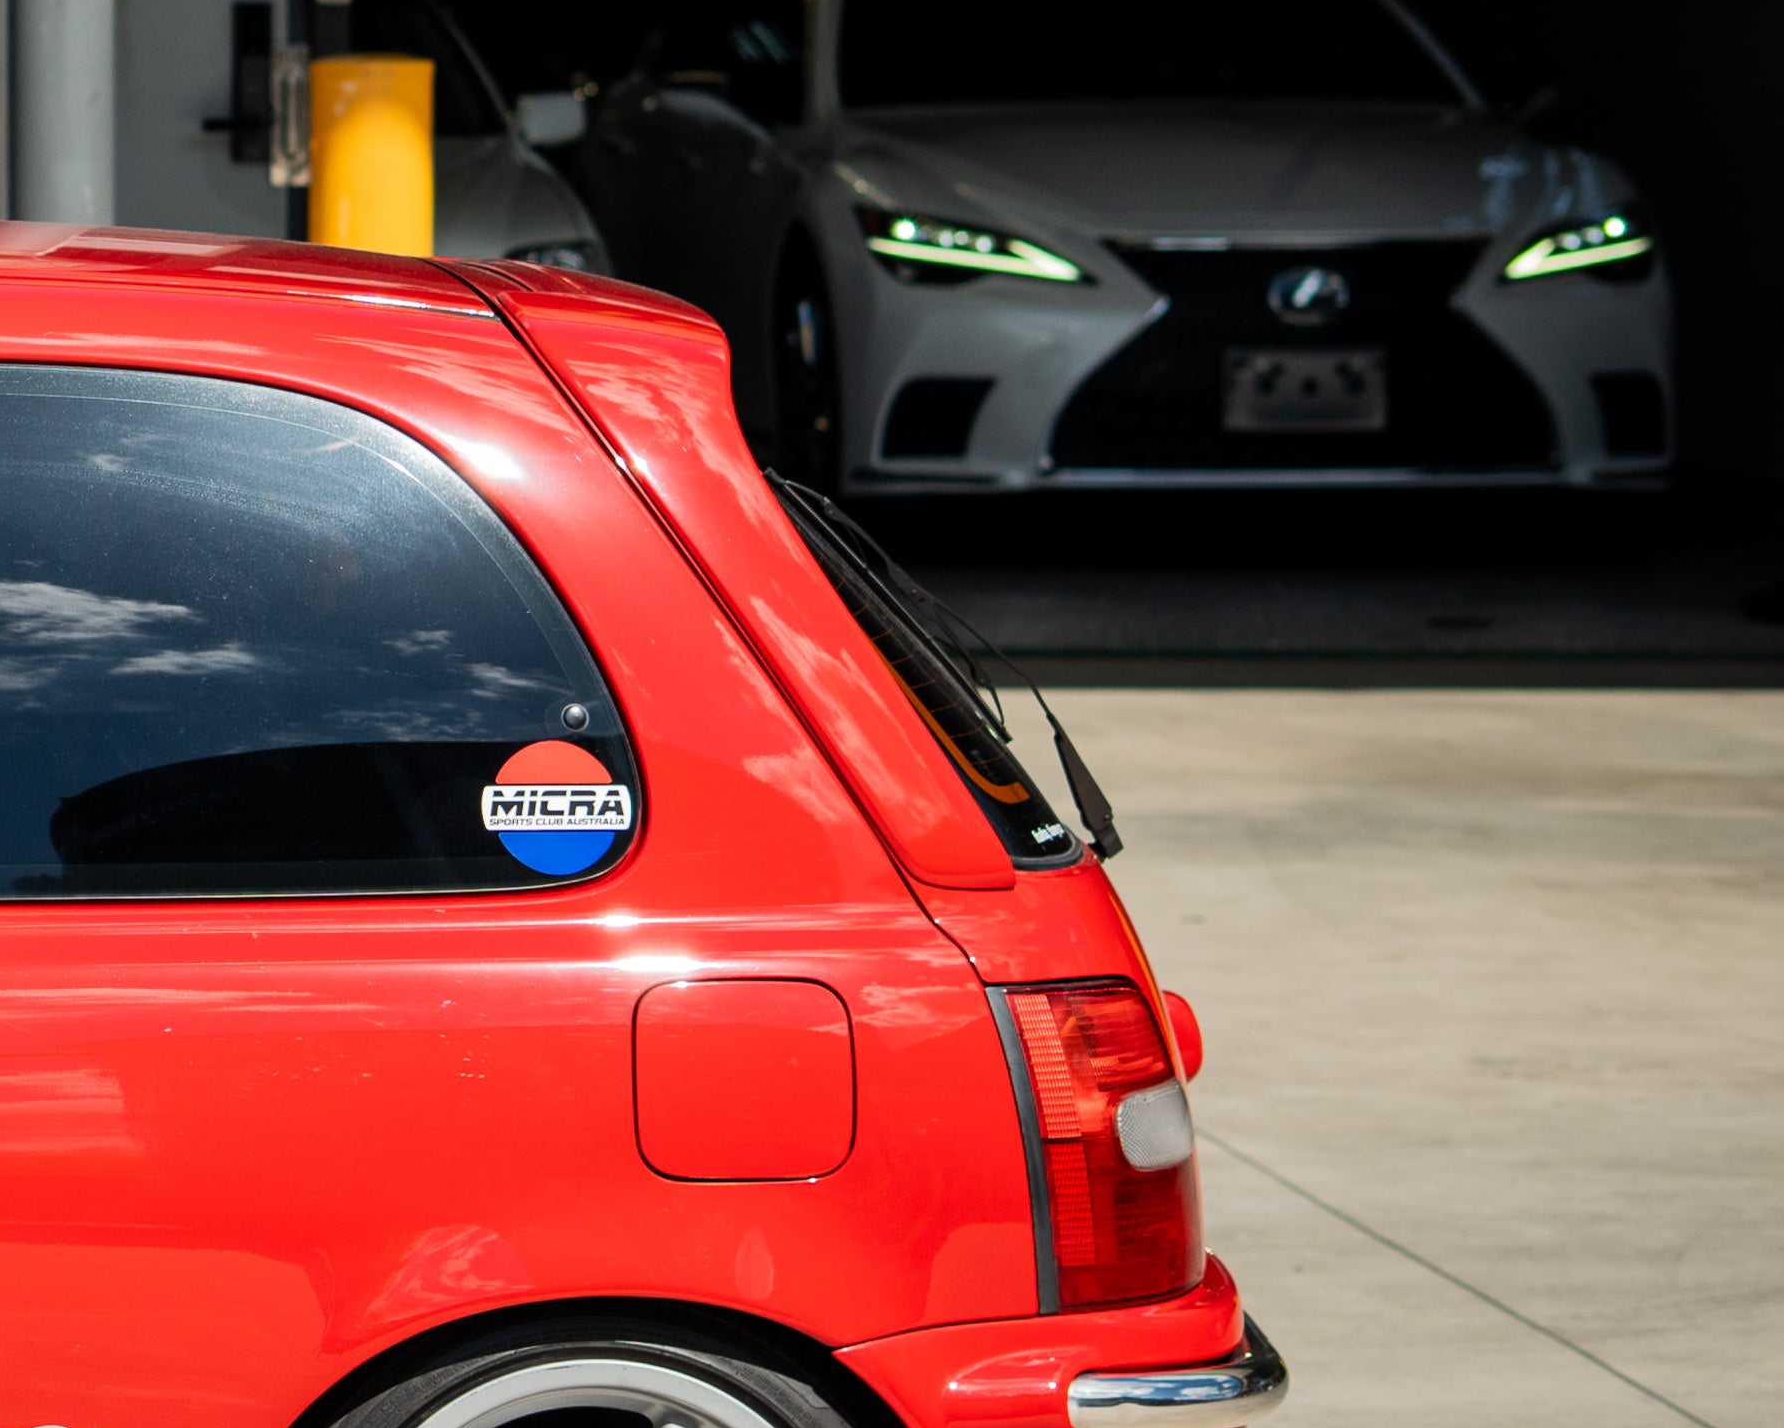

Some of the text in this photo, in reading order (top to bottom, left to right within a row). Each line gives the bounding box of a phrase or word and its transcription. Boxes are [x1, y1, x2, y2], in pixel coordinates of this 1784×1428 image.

[490, 789, 625, 817] MICRA
[489, 818, 625, 826] SPORTS CLUB AUSTRALIA
